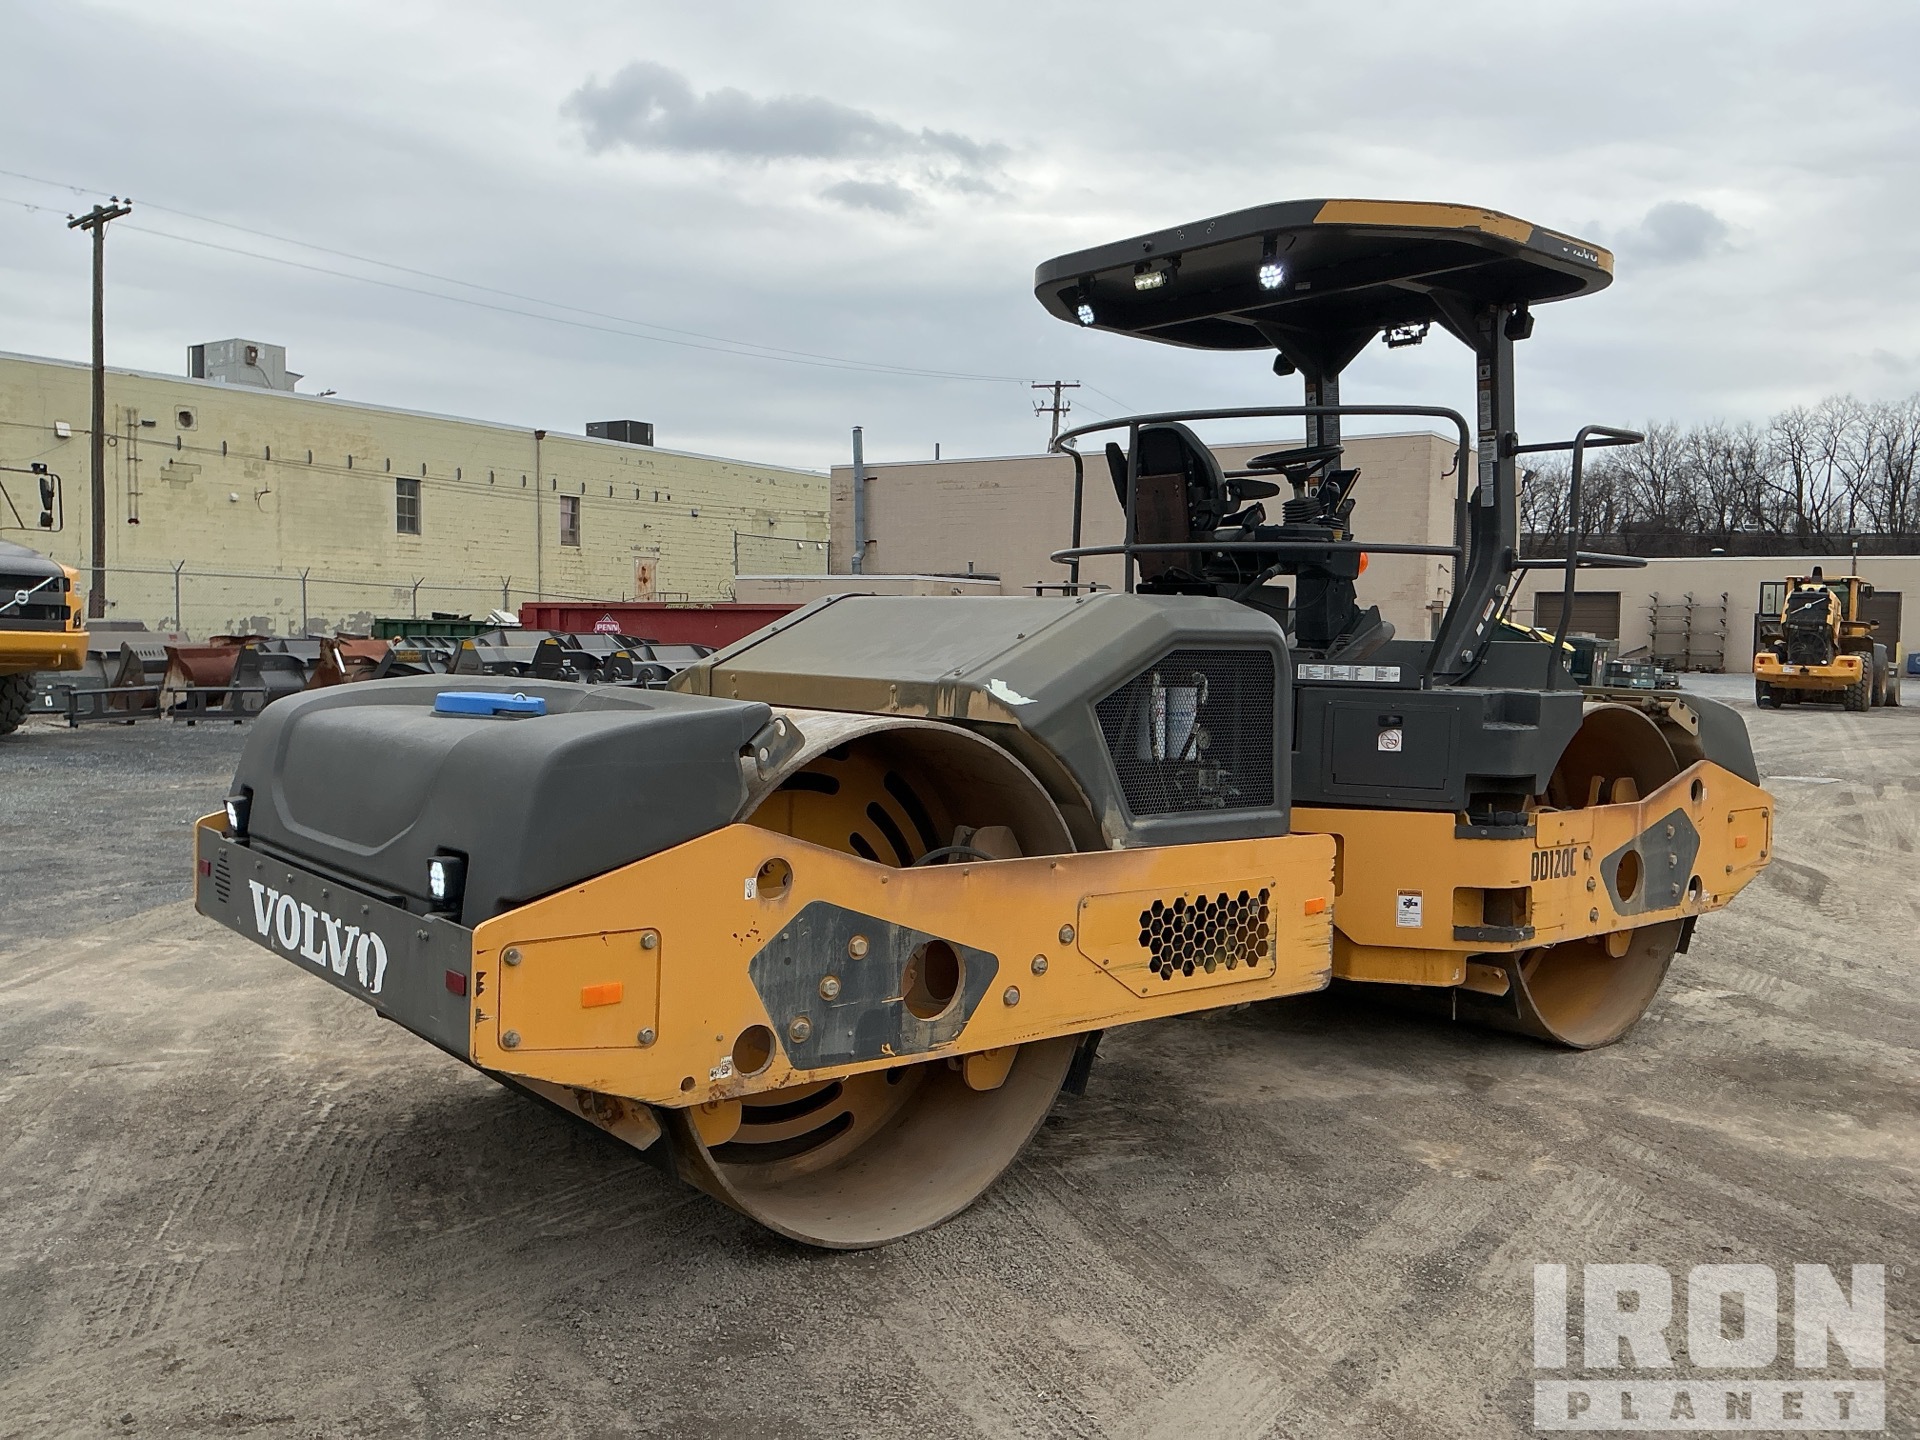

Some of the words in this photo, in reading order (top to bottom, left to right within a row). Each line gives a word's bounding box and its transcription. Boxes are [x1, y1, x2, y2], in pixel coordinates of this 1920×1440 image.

[596, 623, 618, 631] PENN
[1530, 847, 1578, 882] DD120C
[248, 879, 388, 993] VOLVO
